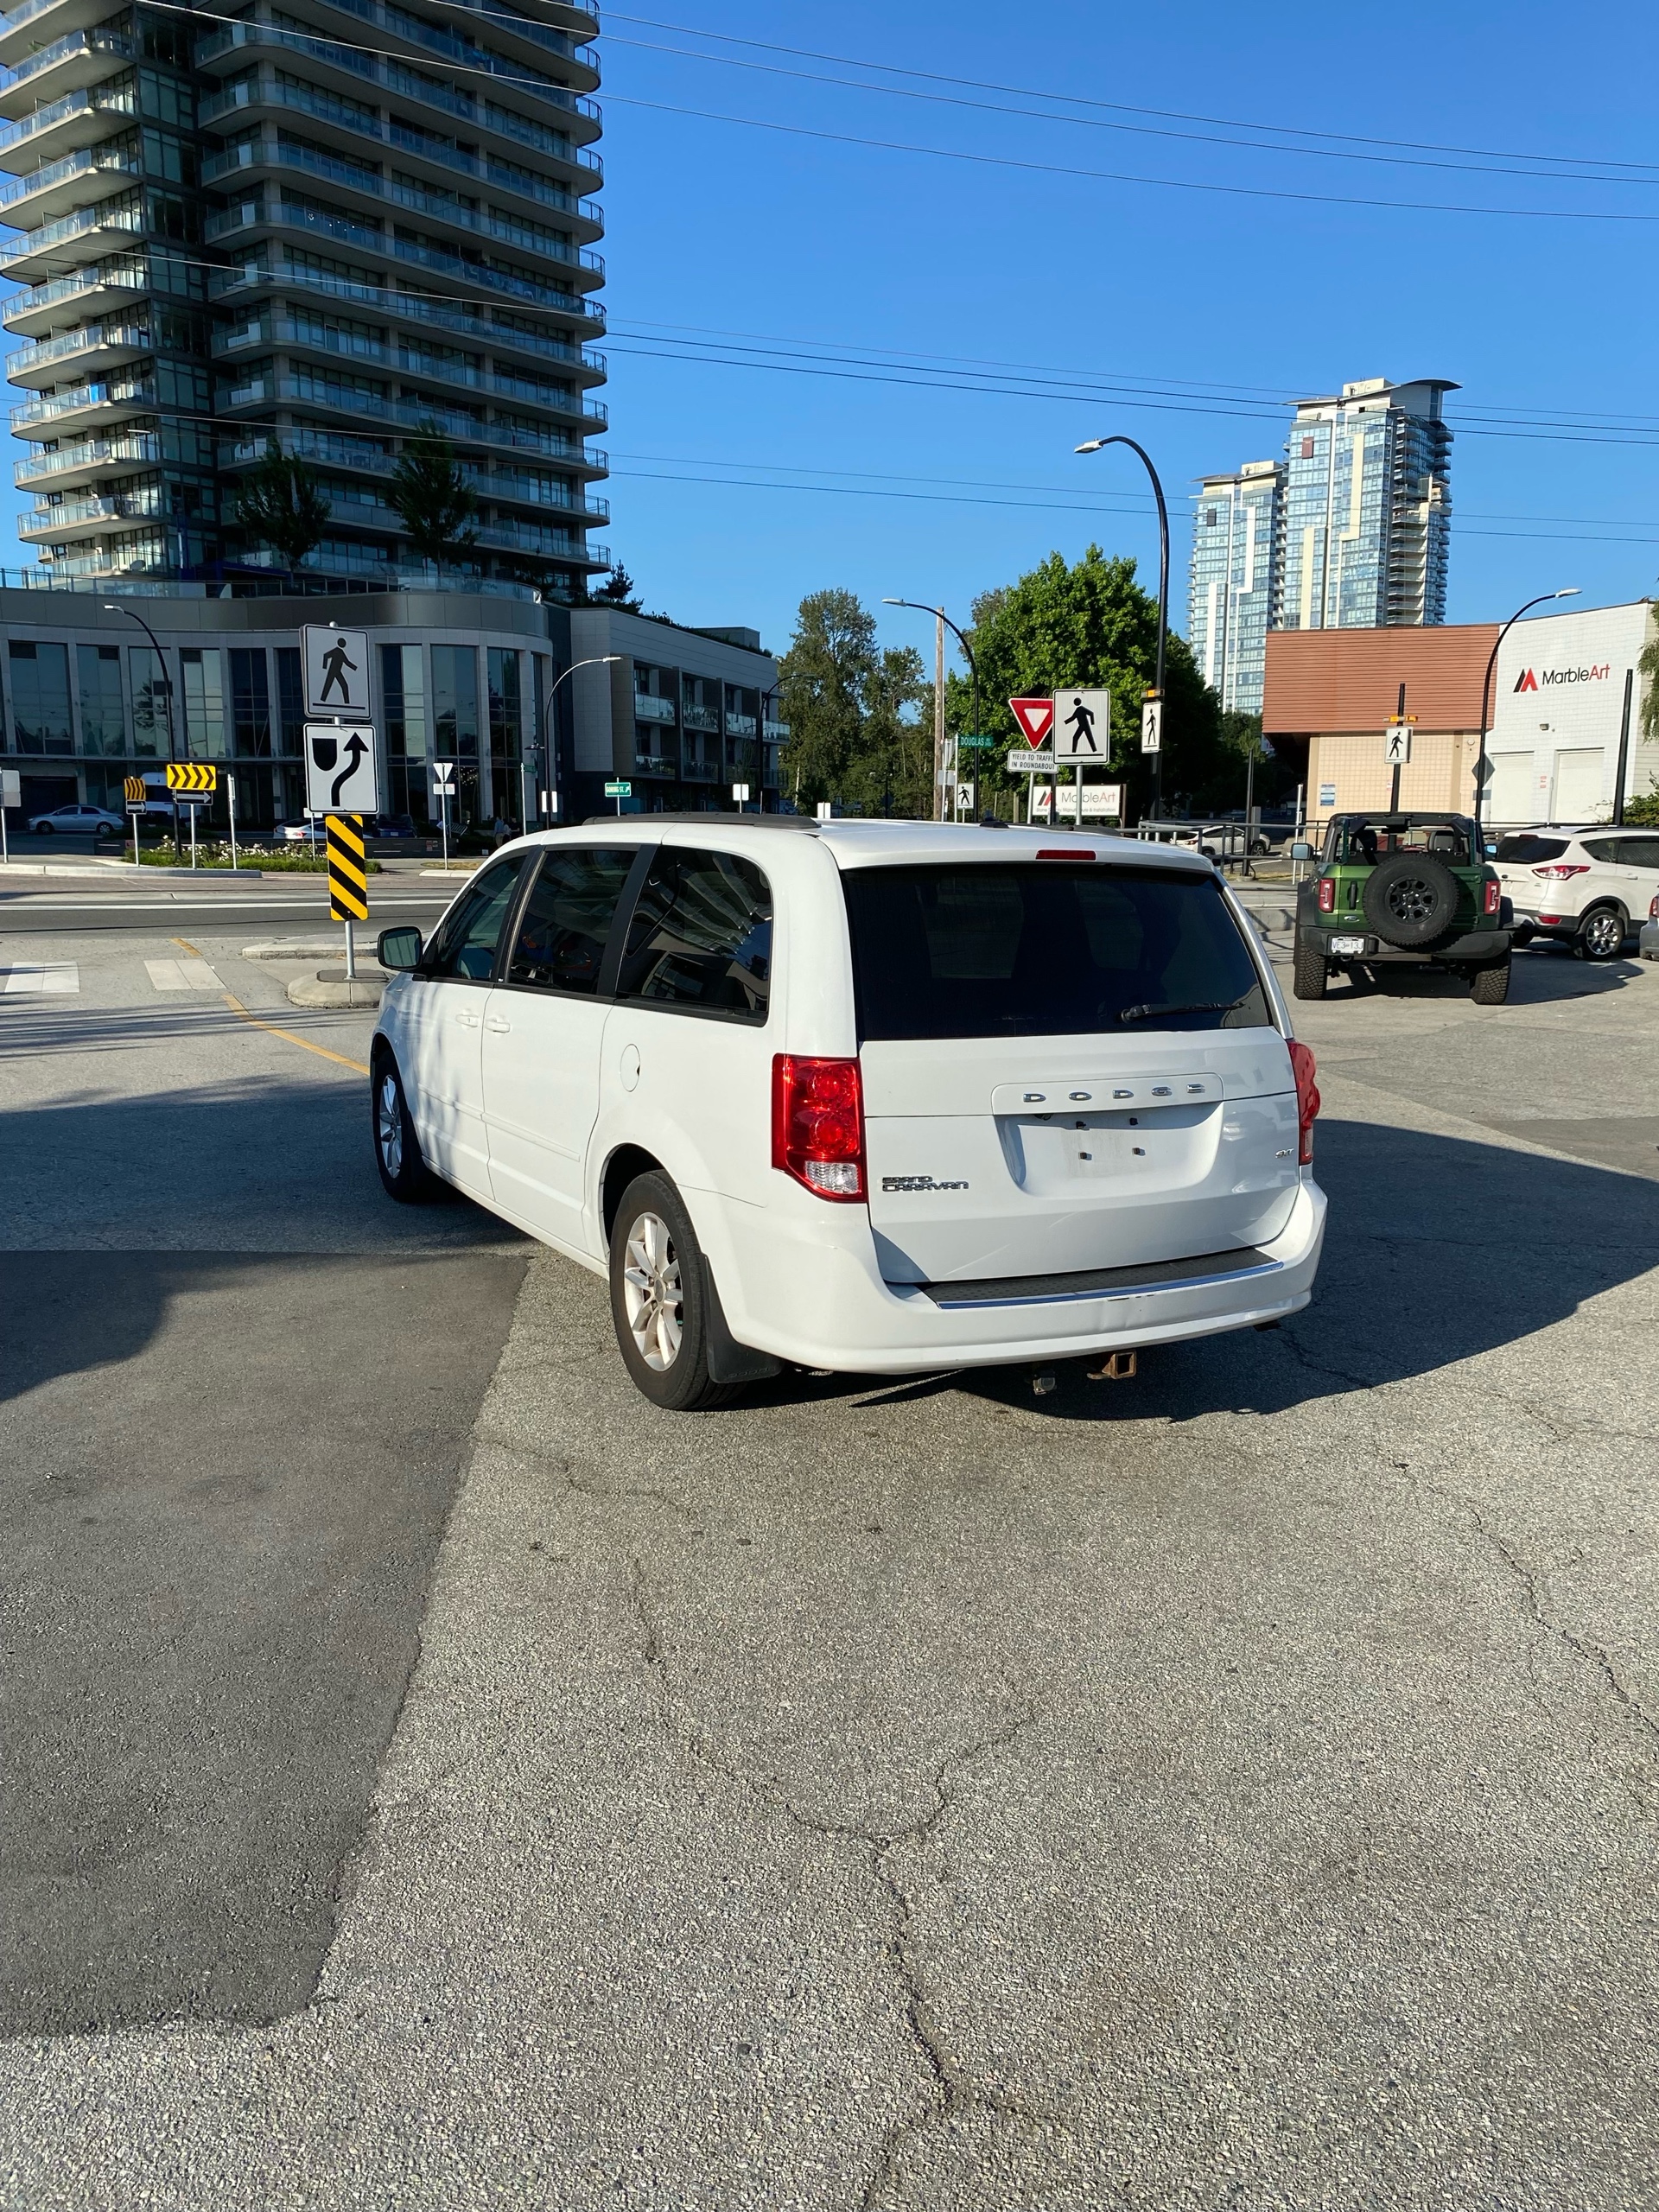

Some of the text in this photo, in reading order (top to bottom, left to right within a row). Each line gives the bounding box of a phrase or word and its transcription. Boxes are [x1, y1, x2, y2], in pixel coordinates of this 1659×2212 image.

[1541, 664, 1611, 685] MarbleArt
[960, 736, 985, 747] DOUGLAS
[1020, 761, 1055, 770] ROUNDABOUT
[1061, 791, 1116, 803] MableArt
[1023, 1083, 1205, 1103] DODGE
[882, 1181, 969, 1192] CARAVAN
